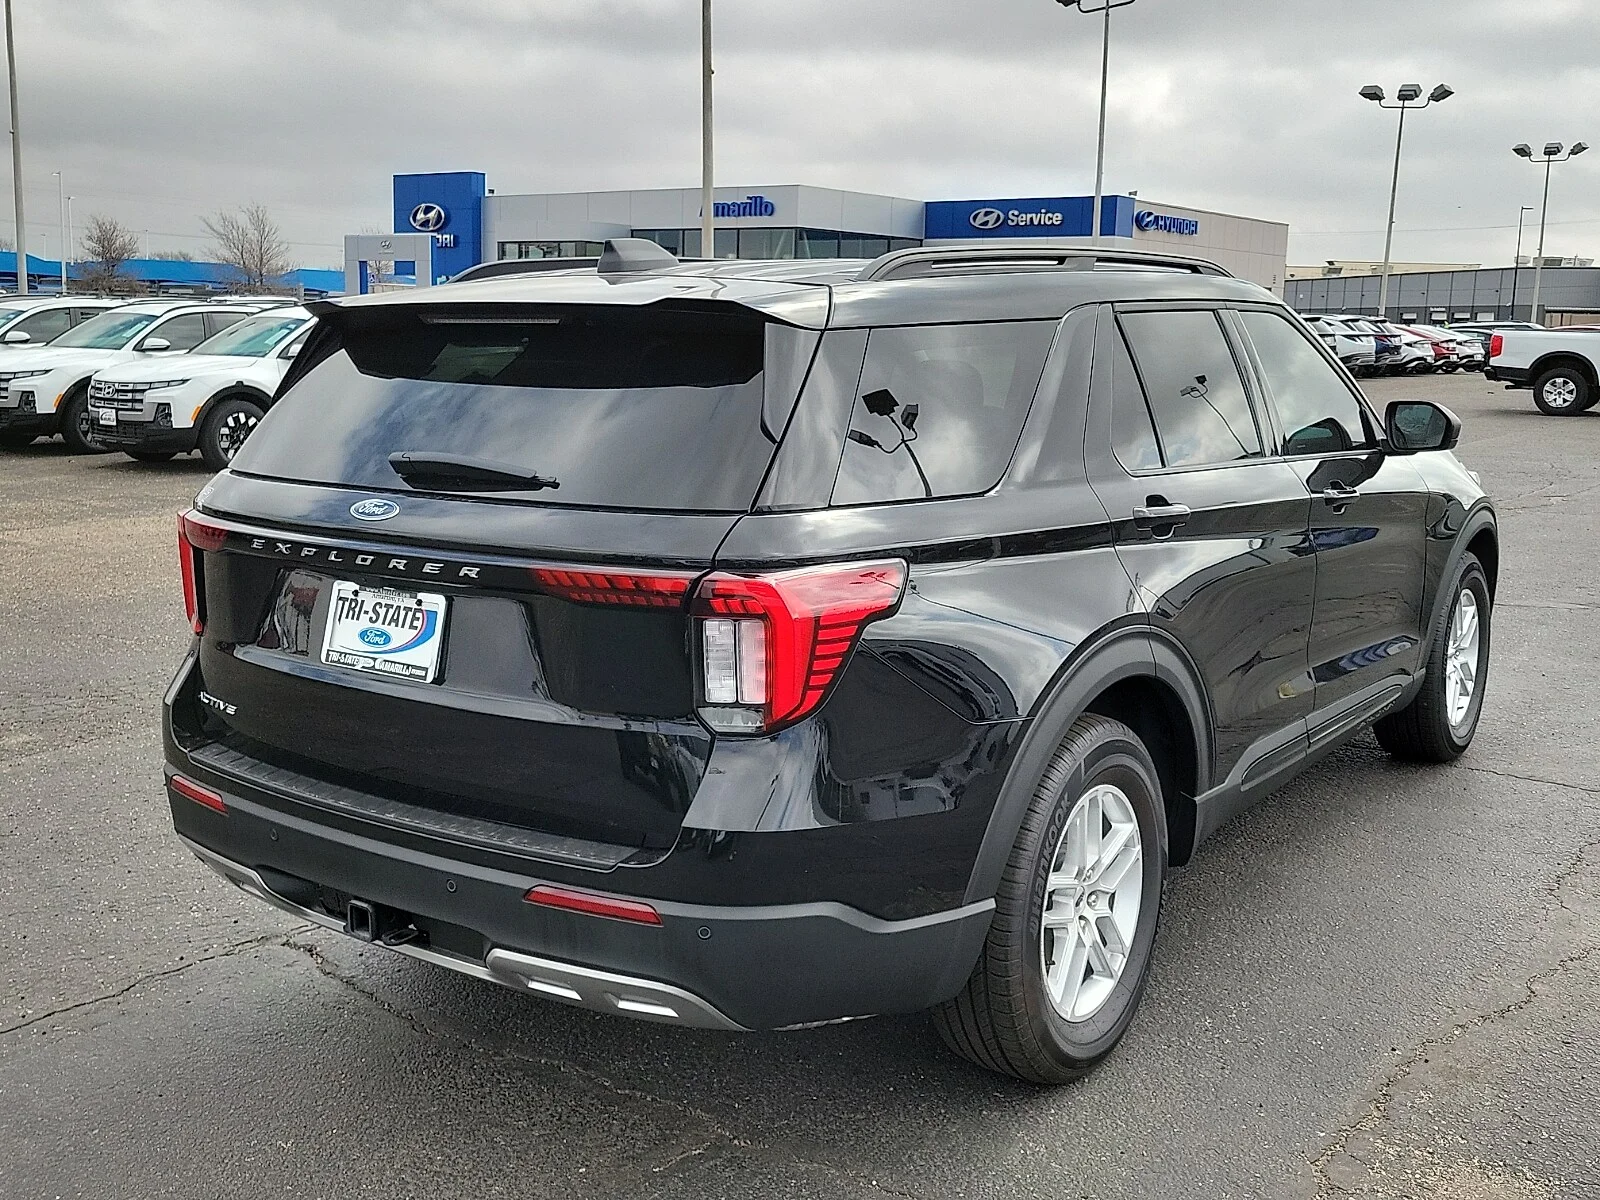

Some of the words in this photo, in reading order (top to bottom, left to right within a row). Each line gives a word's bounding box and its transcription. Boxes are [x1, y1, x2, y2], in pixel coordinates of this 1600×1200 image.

[699, 195, 774, 217] marillo
[1007, 208, 1063, 226] Service
[1153, 215, 1198, 236] HYUNDAI
[251, 538, 481, 579] EXPLORER
[338, 596, 423, 631] TRI-STATE
[364, 629, 386, 645] Ford
[198, 691, 238, 715] ACTIVE
